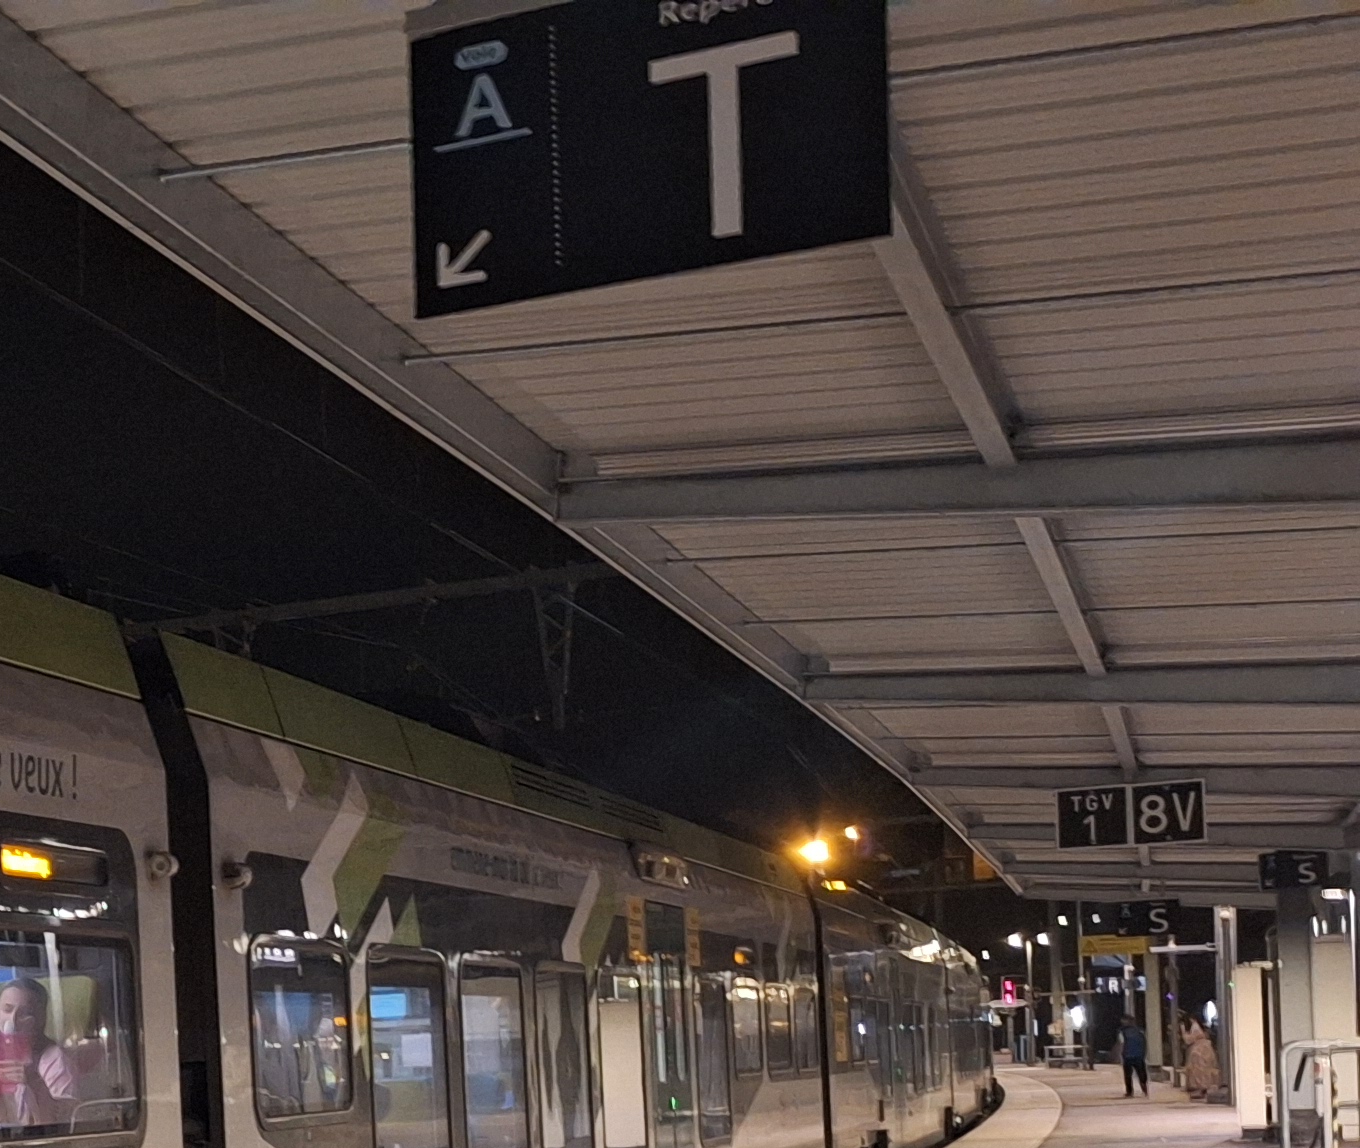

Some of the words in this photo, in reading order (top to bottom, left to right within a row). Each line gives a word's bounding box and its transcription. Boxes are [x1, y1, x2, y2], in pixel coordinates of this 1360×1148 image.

[657, 0, 773, 27] Rep
[454, 72, 514, 138] A
[647, 30, 800, 239] T
[10, 752, 65, 798] veux
[1070, 793, 1114, 813] TGV
[1139, 790, 1196, 834] 8V
[1082, 814, 1098, 845] 1
[1297, 861, 1317, 884] S
[1148, 908, 1169, 933] S
